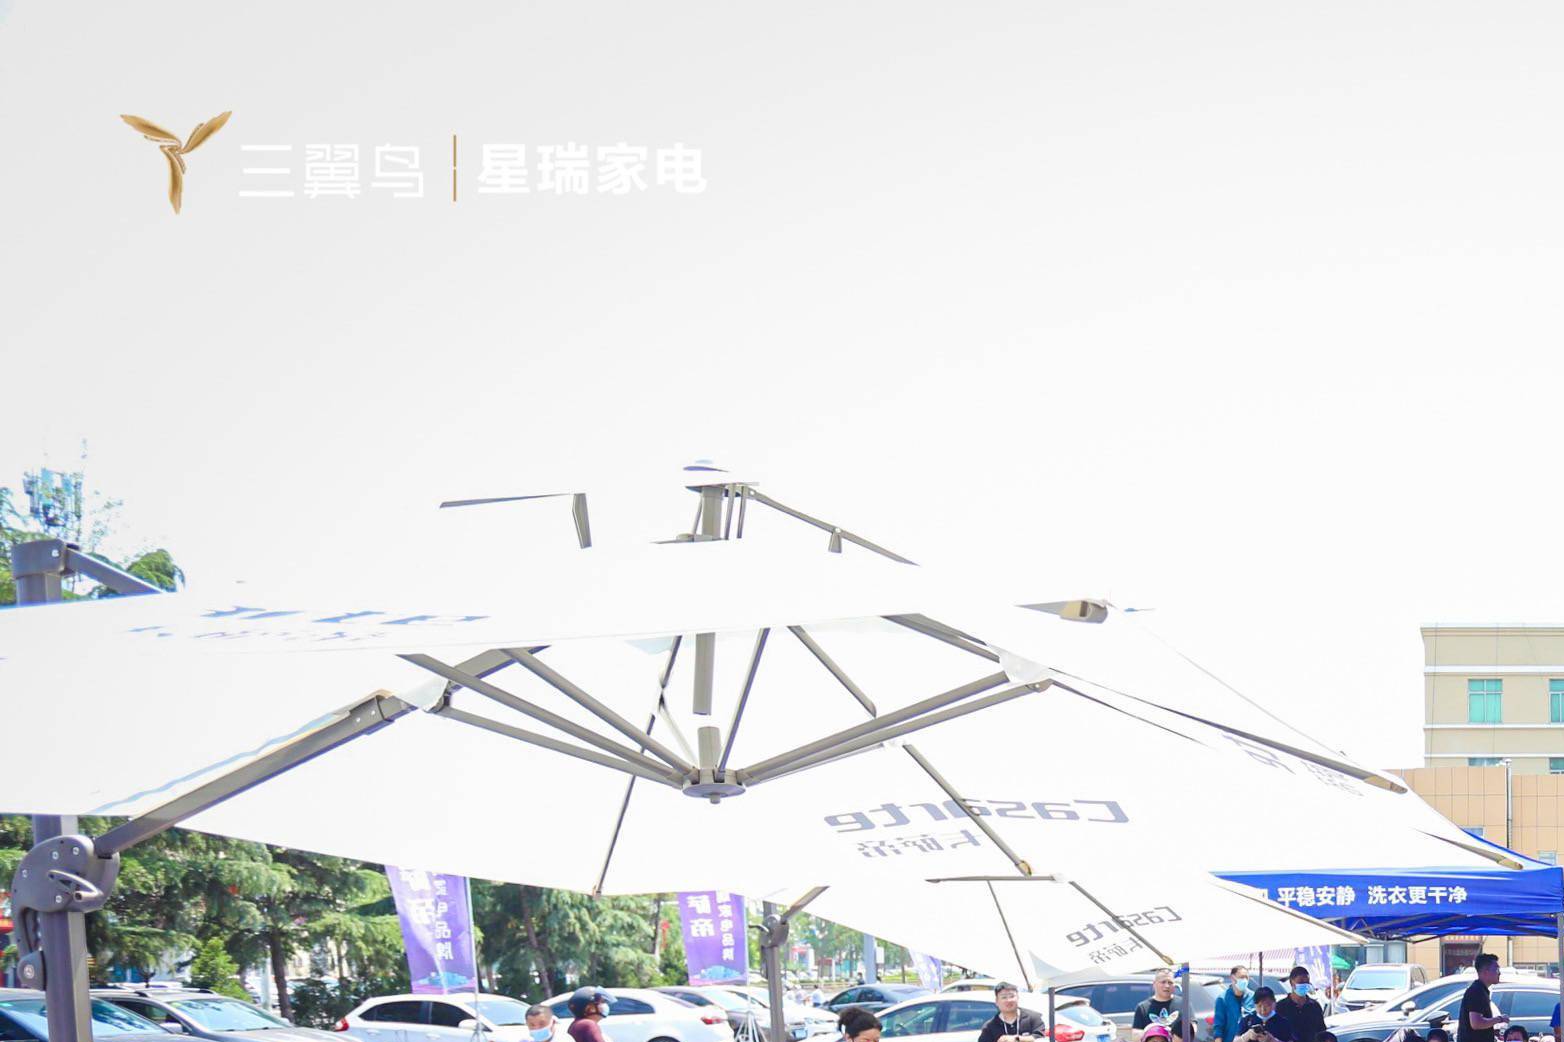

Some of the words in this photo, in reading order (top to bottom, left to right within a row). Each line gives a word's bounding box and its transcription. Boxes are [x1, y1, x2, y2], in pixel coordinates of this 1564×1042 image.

[1276, 885, 1356, 907] 平稳安静
[1367, 885, 1468, 905] 洗衣更干净
